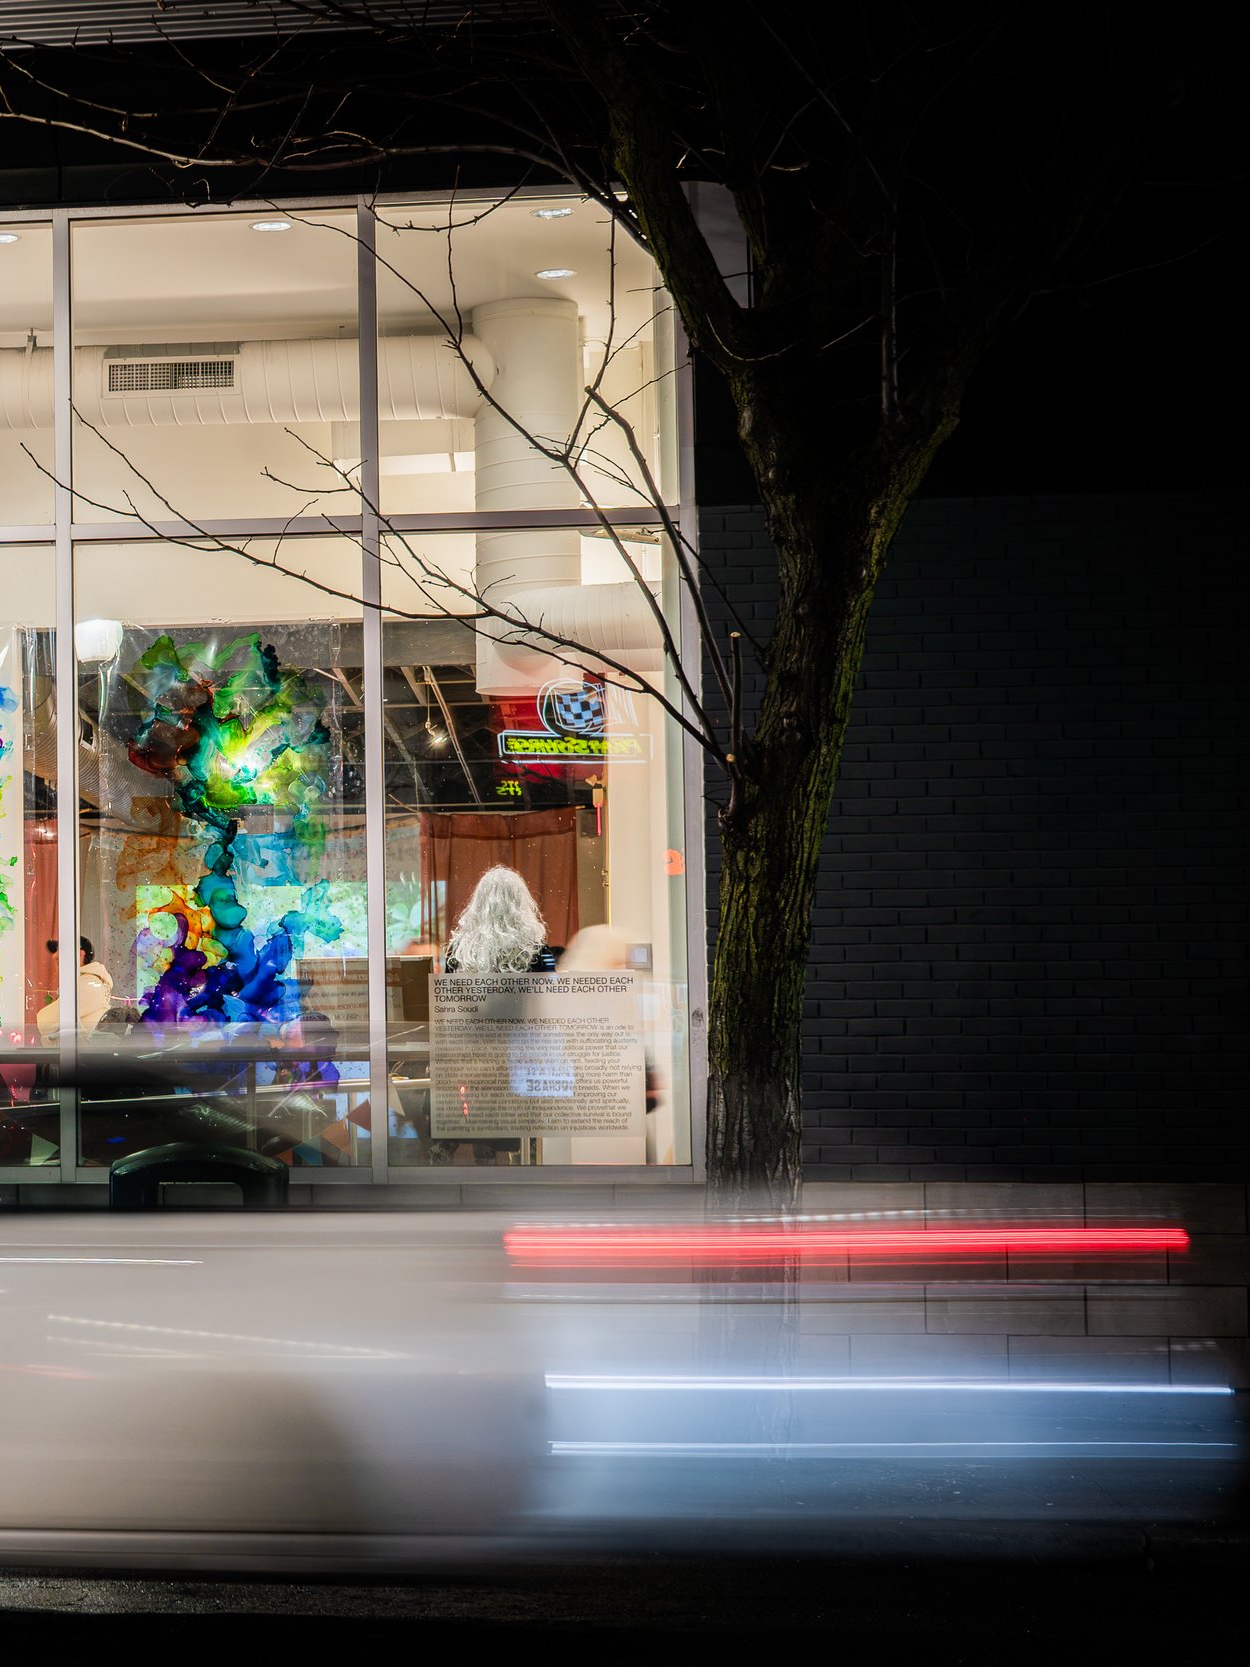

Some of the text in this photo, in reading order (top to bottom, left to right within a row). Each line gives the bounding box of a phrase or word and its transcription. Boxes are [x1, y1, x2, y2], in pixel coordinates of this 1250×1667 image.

[450, 978, 472, 986] NEED
[475, 978, 498, 986] EACH
[466, 986, 516, 995] YESTERDAY,
[518, 986, 543, 994] WE'LL
[597, 985, 627, 993] OTHER
[458, 1005, 479, 1013] Soudi
